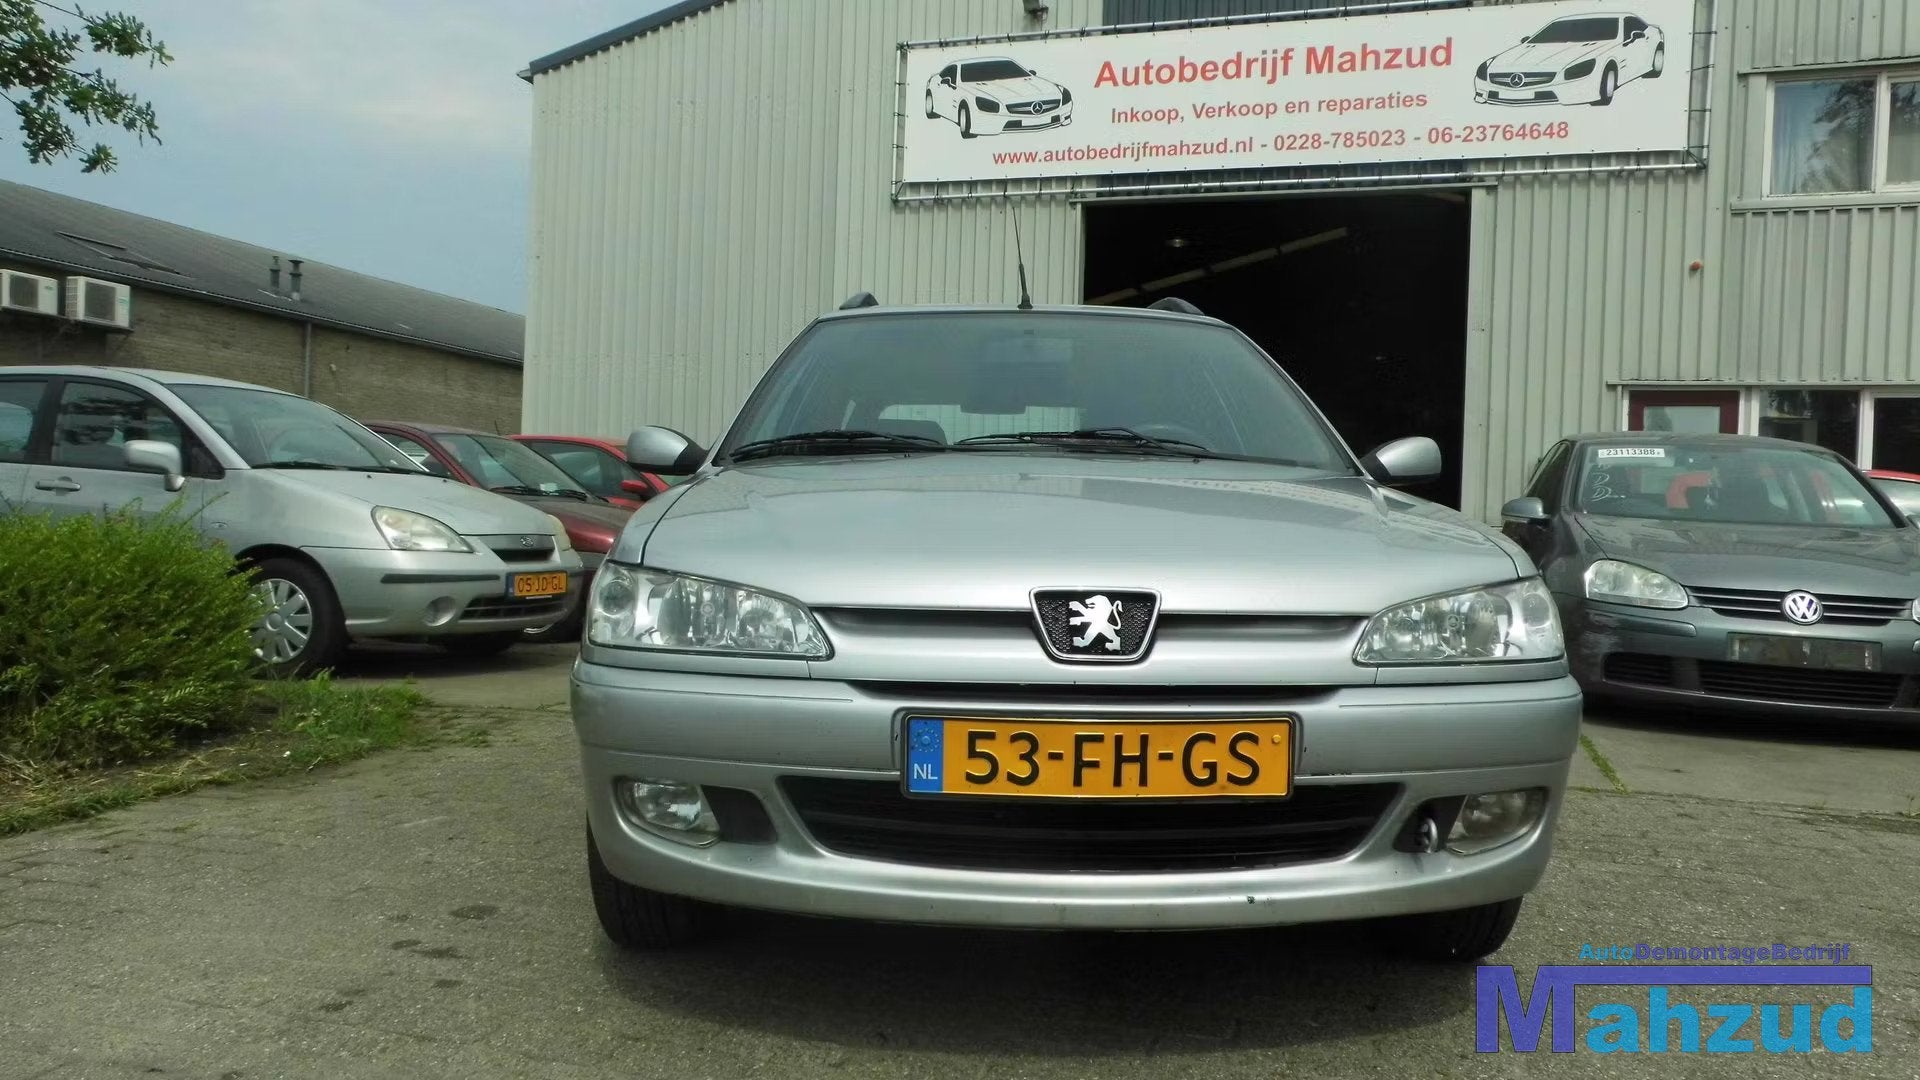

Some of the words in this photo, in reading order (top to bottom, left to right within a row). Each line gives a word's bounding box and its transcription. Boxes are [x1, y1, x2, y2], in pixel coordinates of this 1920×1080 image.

[1094, 47, 1295, 88] Autobedrijf
[1305, 37, 1453, 75] Mahzud
[1111, 107, 1185, 125] Inkoop,
[1192, 101, 1278, 120] Verkoop
[1285, 100, 1310, 114] en
[1317, 91, 1428, 116] reparaties
[993, 136, 1254, 166] www.autobedrijfmahzud.nl
[1273, 128, 1406, 151] 0228-785023
[1427, 121, 1569, 145] 06-23764648
[912, 764, 938, 780] NL
[965, 729, 1260, 788] 53-FH-GS
